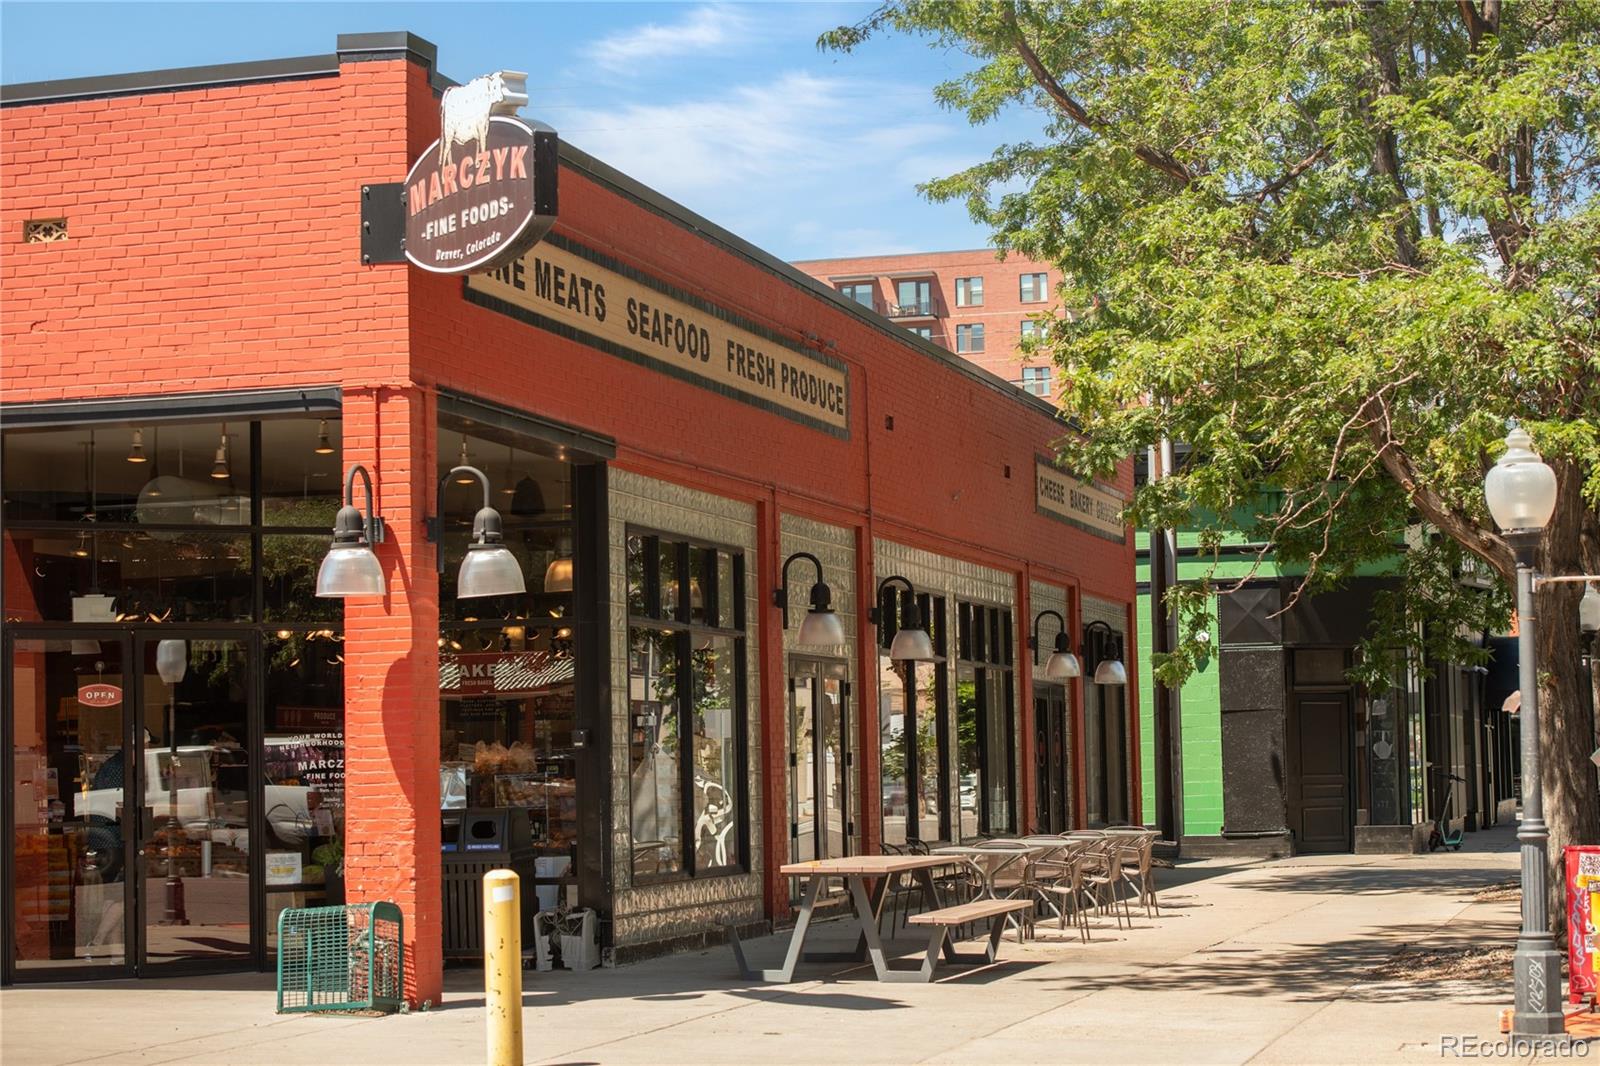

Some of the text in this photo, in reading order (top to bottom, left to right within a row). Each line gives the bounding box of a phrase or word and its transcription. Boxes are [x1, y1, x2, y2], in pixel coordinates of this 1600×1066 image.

[409, 145, 528, 216] MARCZYK
[435, 231, 501, 261] Denver, Colorado
[486, 255, 844, 416] NE MEATS SEAFOOD FRESH PRODUCE
[1039, 476, 1065, 505] CHEESE
[1070, 489, 1093, 516] BAKERY
[85, 691, 115, 699] OPEN
[314, 732, 343, 740] WORLD
